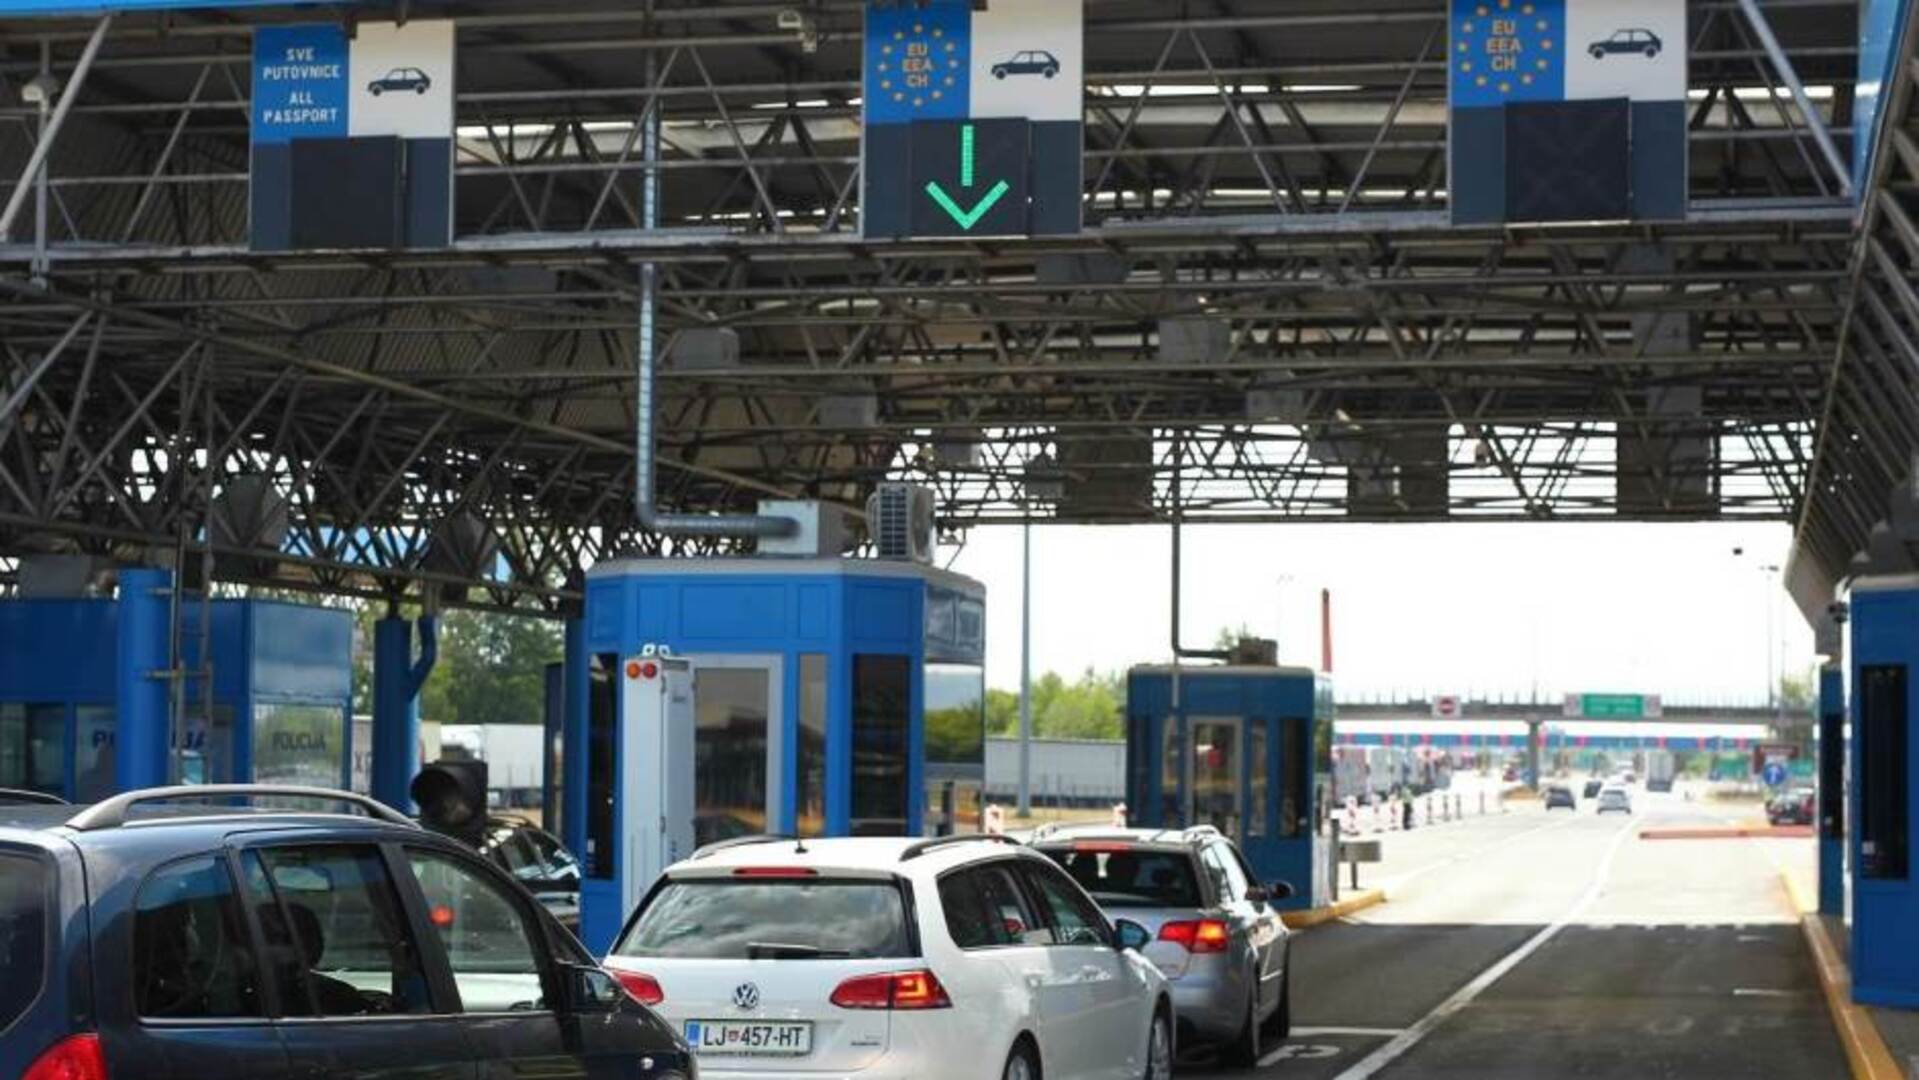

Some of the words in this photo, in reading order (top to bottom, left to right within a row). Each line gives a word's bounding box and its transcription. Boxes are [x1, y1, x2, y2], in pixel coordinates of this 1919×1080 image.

[1492, 20, 1516, 34] EU
[907, 43, 928, 56] EU
[1486, 39, 1522, 53] EEA
[286, 48, 315, 61] SVE
[902, 58, 933, 72] EEA
[1491, 56, 1517, 71] CH
[262, 65, 340, 80] PUTOVNICE
[907, 75, 928, 88] CH
[289, 91, 313, 104] ALL
[263, 108, 338, 123] PASSPORT
[703, 1026, 727, 1047] LJ
[740, 1026, 805, 1047] 457-HT
